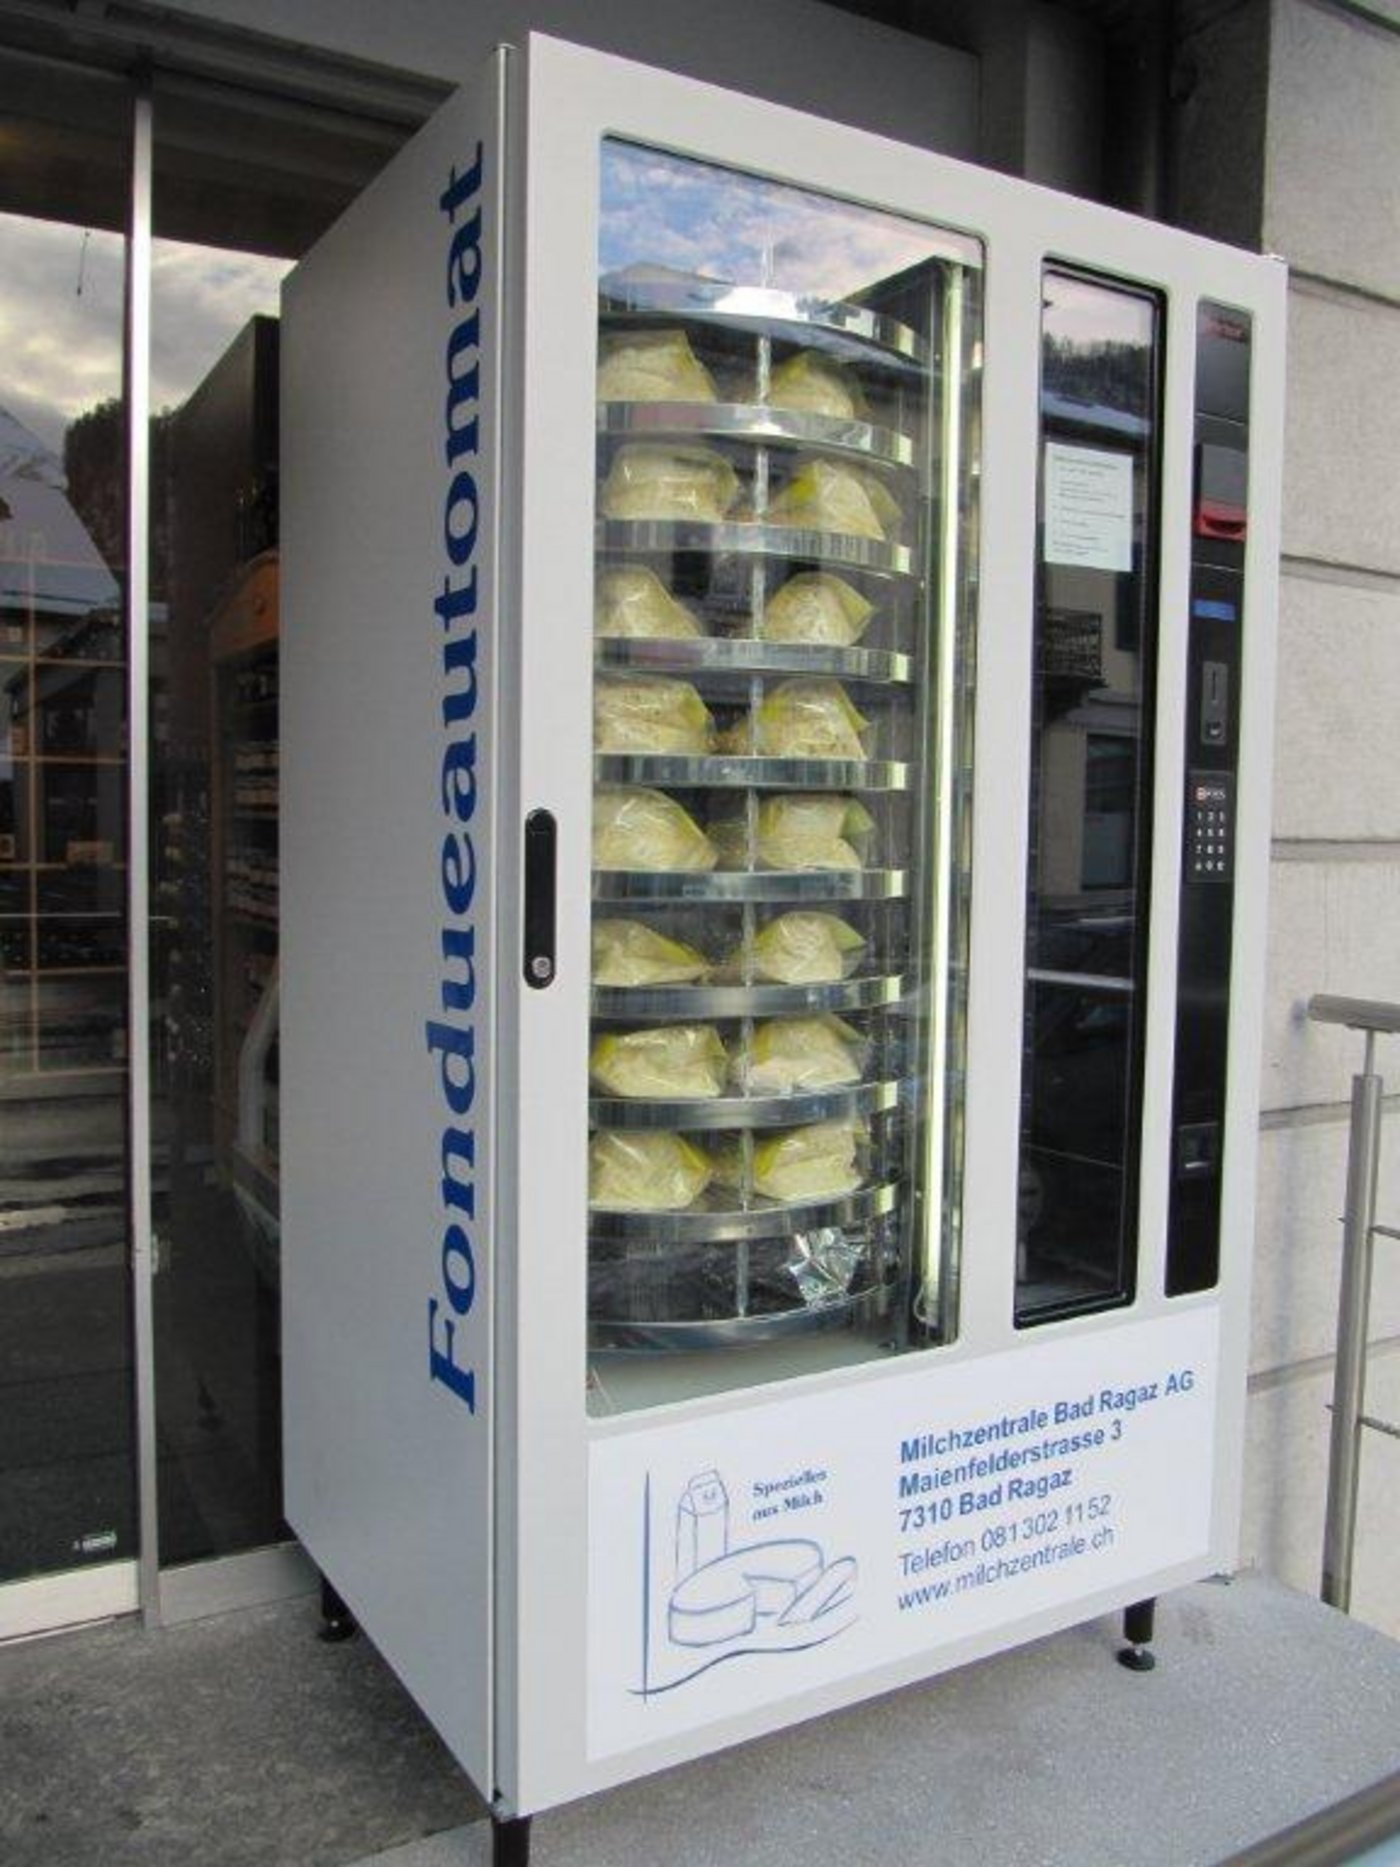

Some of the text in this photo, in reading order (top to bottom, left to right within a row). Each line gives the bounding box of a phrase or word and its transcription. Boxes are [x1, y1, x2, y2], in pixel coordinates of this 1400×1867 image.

[425, 139, 484, 1416] Fondueautomat
[901, 1369, 1195, 1464] Milchzentrale Bad Ragaz AG
[899, 1418, 1122, 1499] Maienfelderstrasse 3
[783, 1489, 823, 1511] Milch
[898, 1469, 1073, 1533] 7310 Bad Ragaz
[897, 1525, 1115, 1611] www.milchzentrale.ch
[899, 1537, 976, 1577] Telefon
